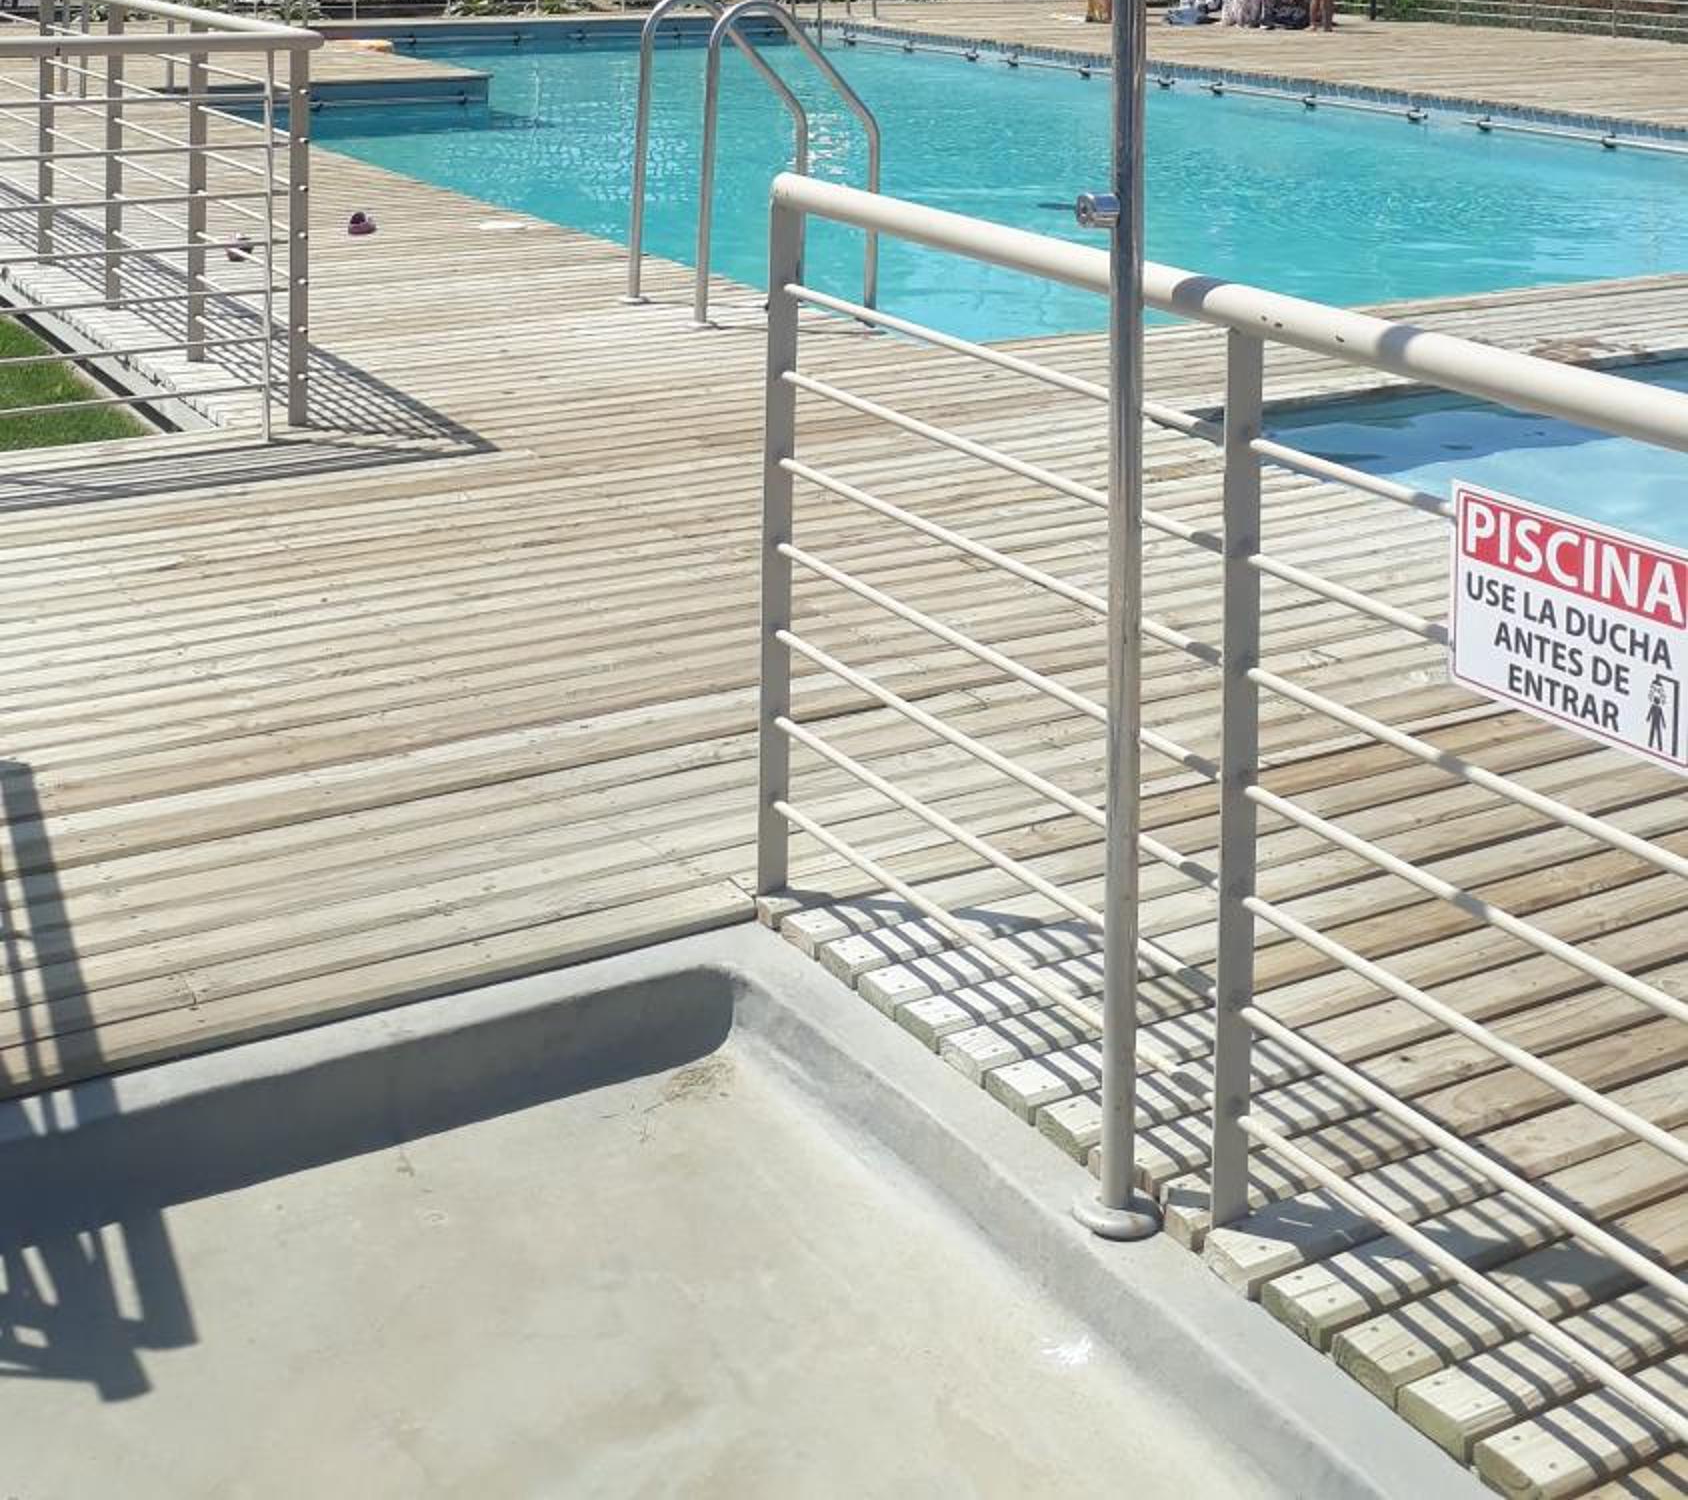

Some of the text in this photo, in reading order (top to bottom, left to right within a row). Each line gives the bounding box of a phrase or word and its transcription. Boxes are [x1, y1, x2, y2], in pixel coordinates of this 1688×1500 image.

[1465, 501, 1683, 623] PISCINA
[1466, 571, 1673, 670] USE LA DUCHA
[1494, 622, 1631, 695] ANTES DE
[1509, 664, 1620, 733] ENTRAR
